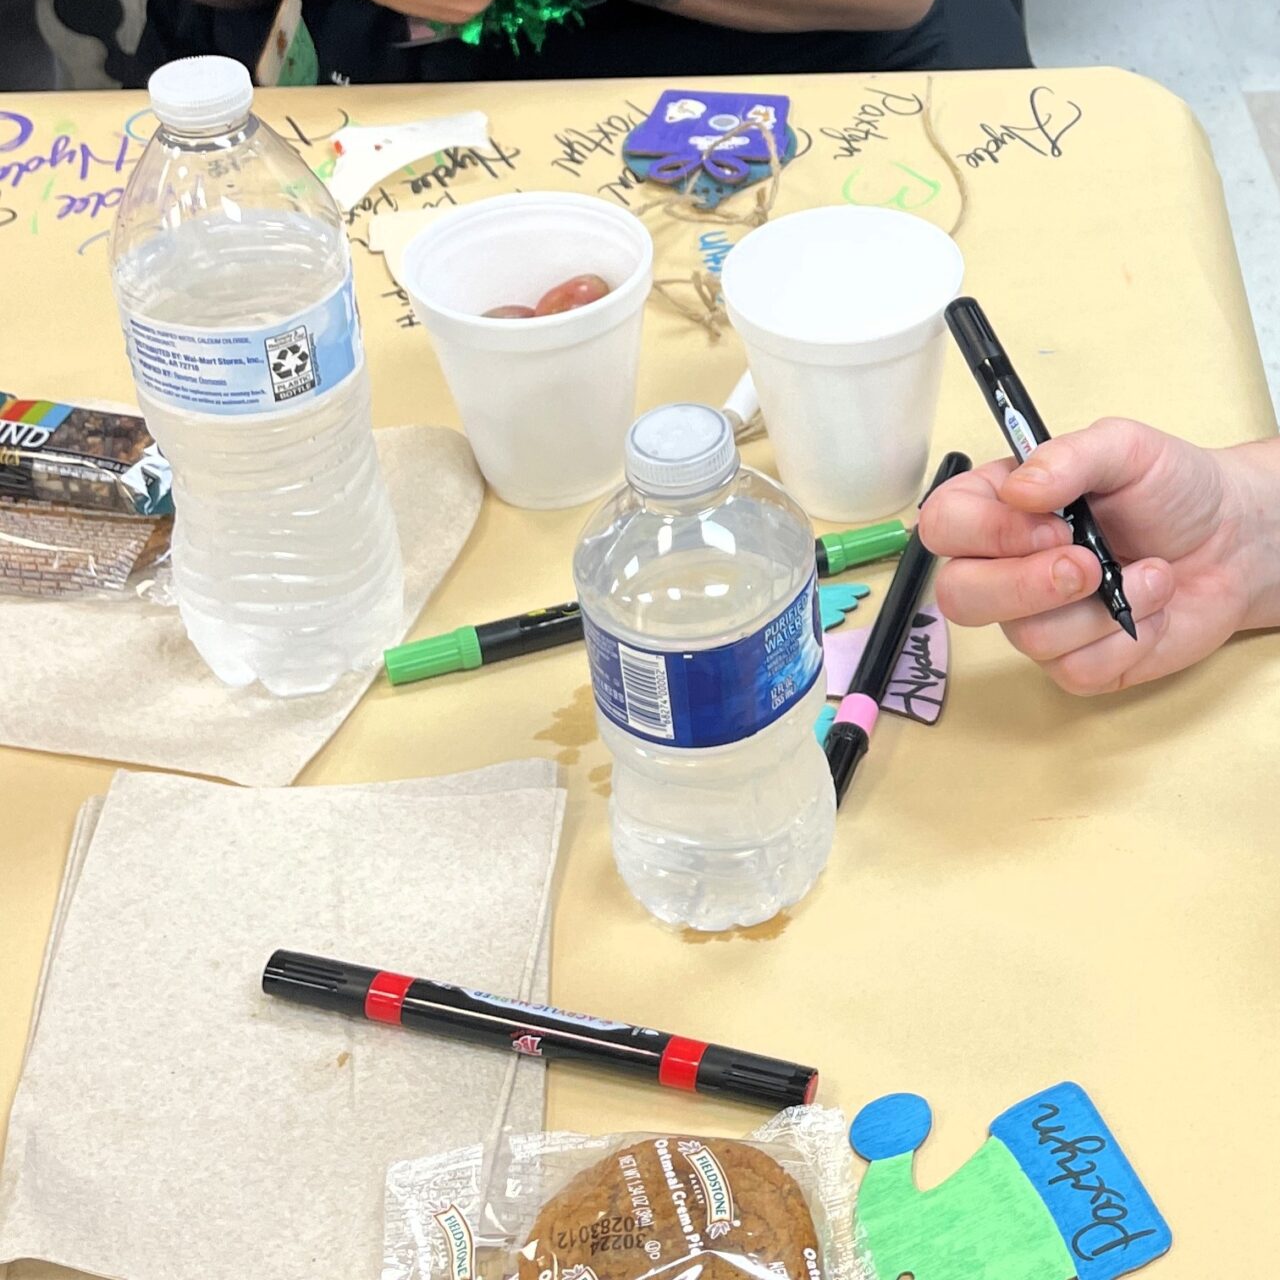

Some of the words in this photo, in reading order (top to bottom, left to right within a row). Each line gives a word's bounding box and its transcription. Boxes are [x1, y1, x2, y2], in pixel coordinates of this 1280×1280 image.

[276, 375, 310, 391] PLASTIC
[279, 383, 313, 400] BOTTLE
[654, 1138, 678, 1191] Oatmeal
[671, 1190, 695, 1232] Creme
[695, 1154, 728, 1217] FIELDSTONE
[446, 1214, 469, 1278] FIELDSTONE
[590, 1232, 647, 1256] 30224
